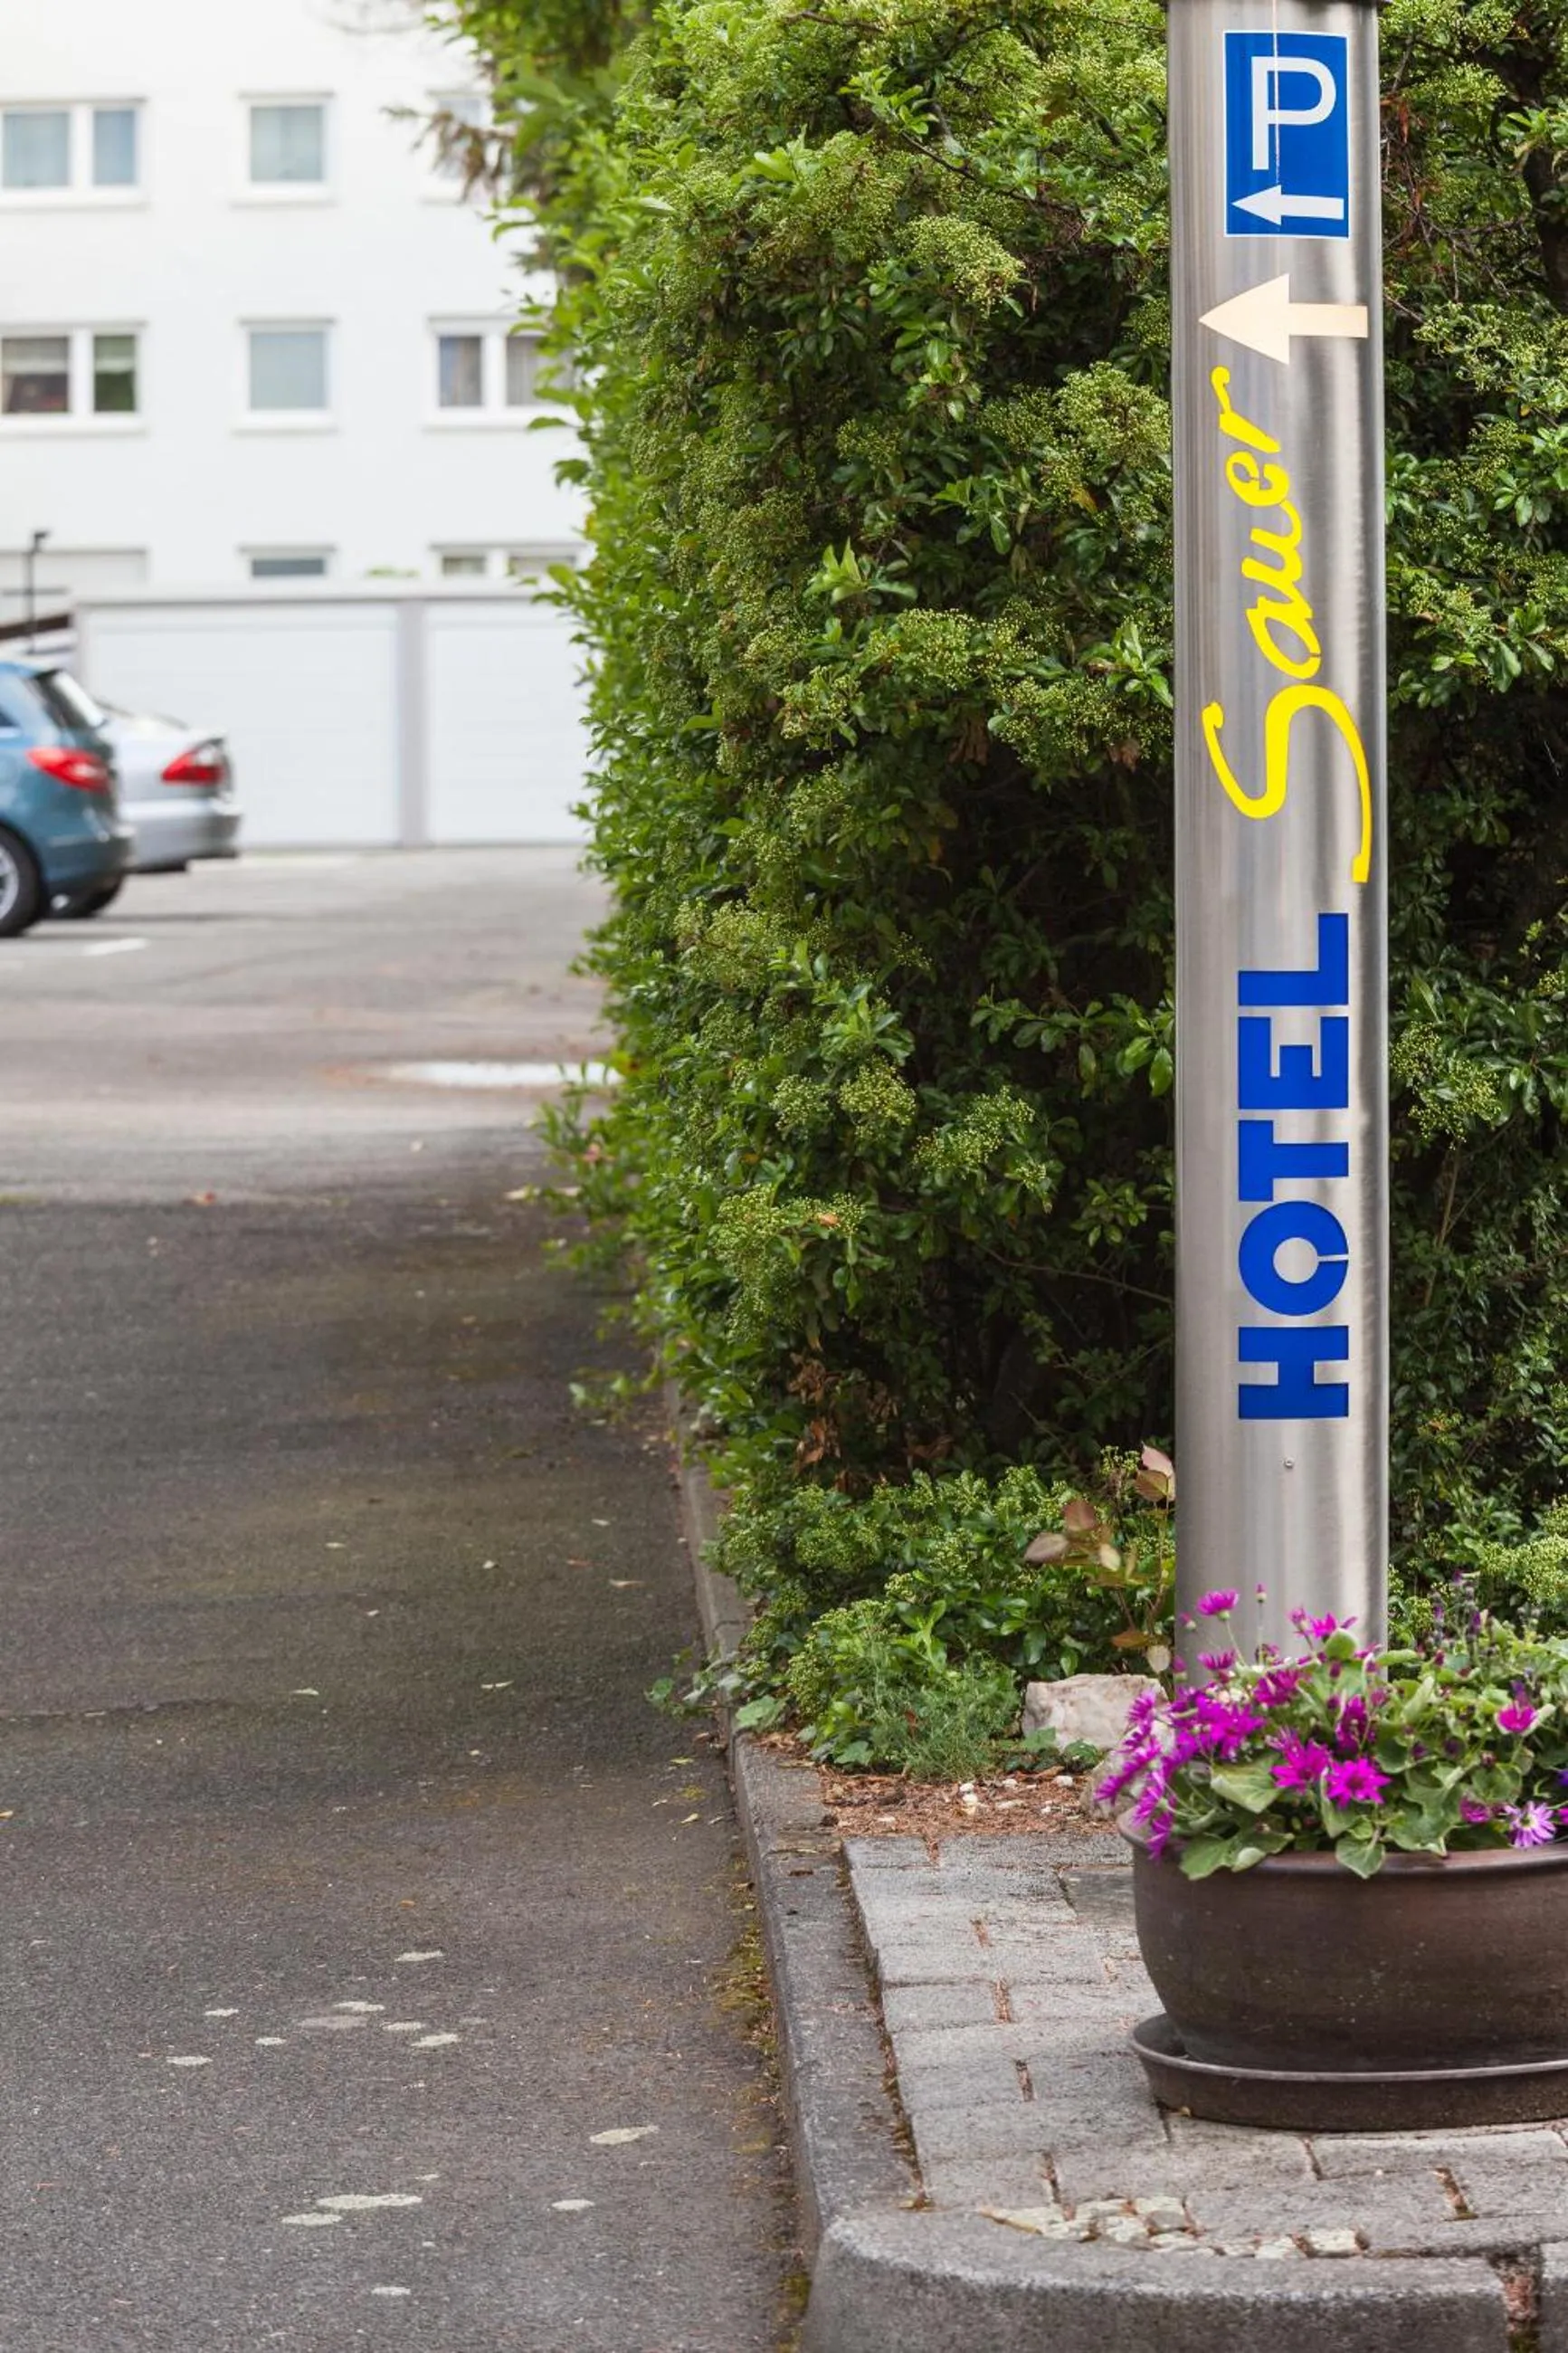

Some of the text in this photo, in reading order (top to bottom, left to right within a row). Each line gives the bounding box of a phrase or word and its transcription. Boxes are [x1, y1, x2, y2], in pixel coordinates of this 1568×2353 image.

[1250, 55, 1337, 171] P
[1201, 365, 1373, 1420] HOTEL Sauer
